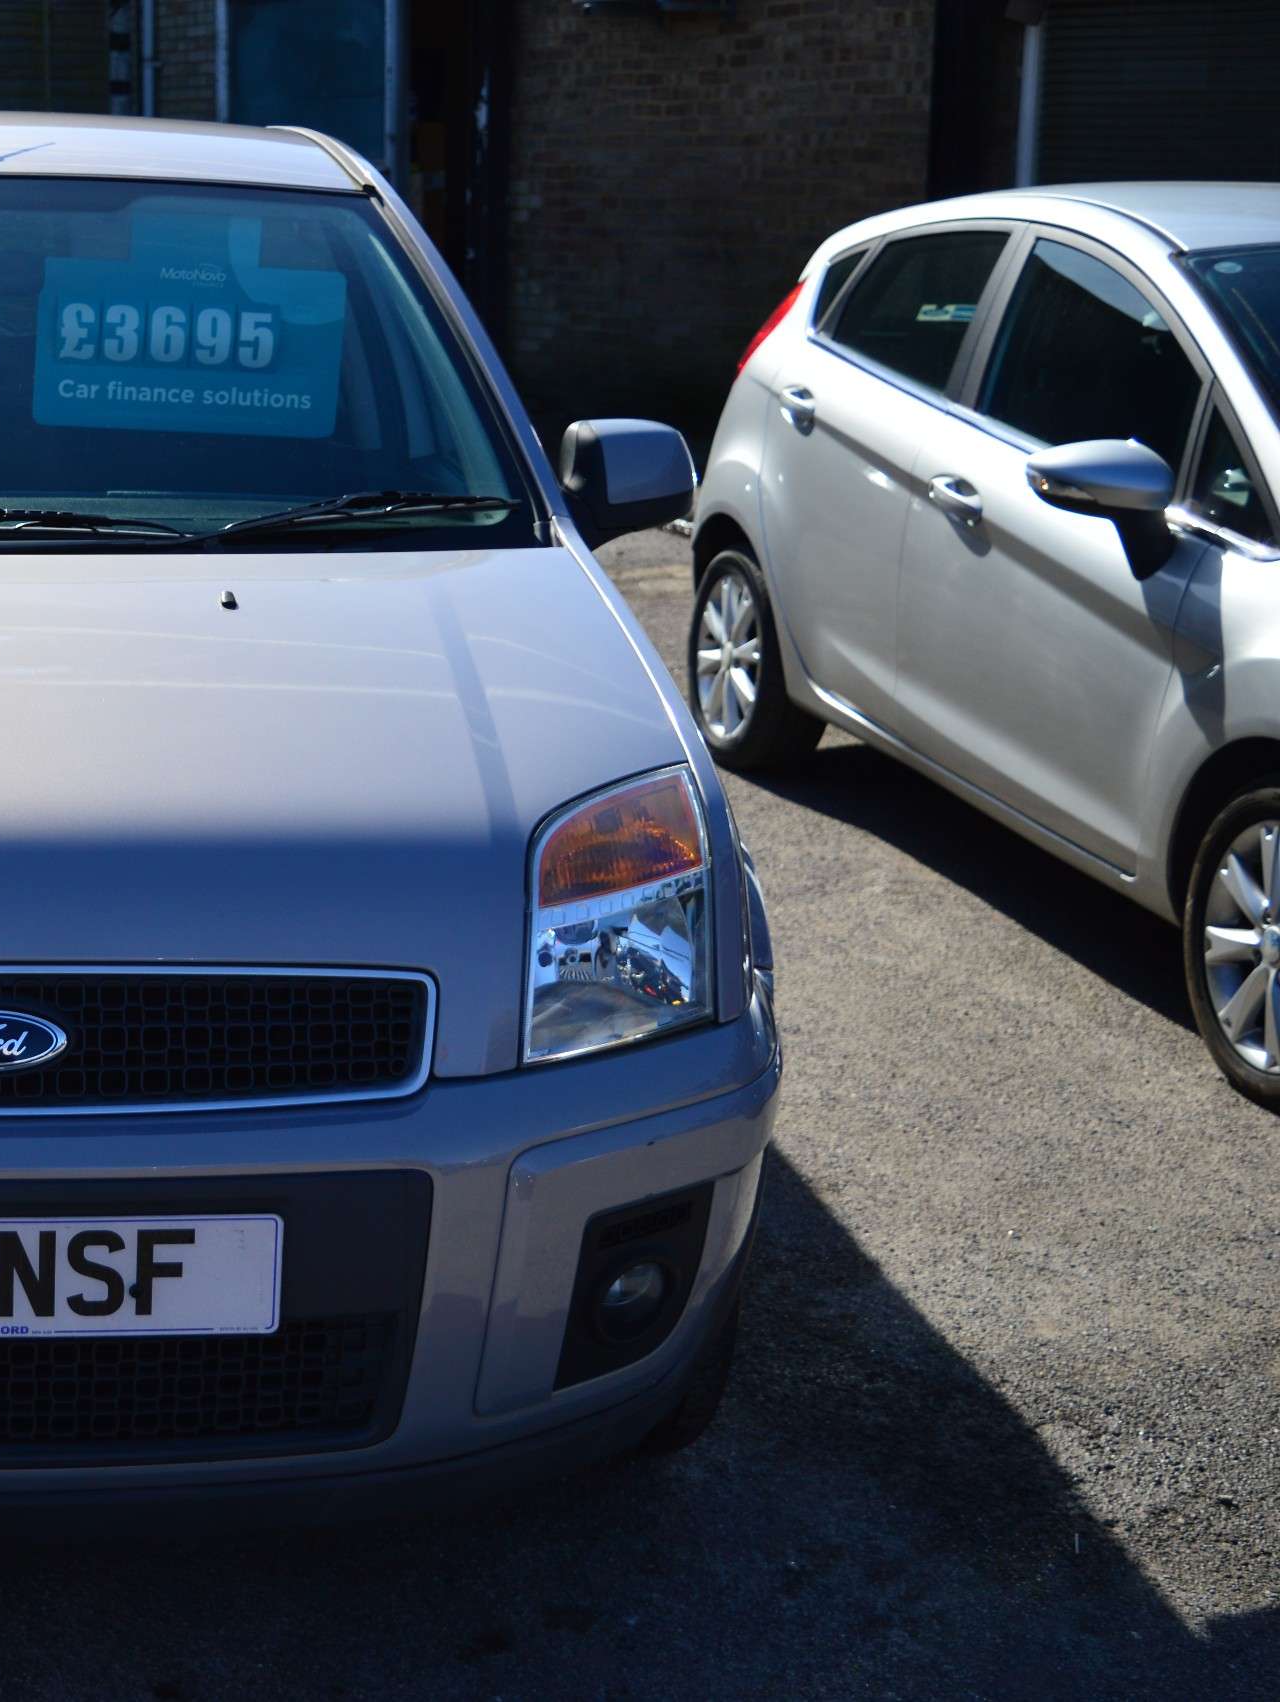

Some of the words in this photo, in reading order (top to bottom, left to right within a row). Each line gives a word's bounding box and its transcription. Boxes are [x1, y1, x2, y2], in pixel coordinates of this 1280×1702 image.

[160, 267, 226, 281] MotoNovo
[59, 303, 275, 369] £3695
[58, 379, 100, 399] Car
[107, 381, 194, 404] finance
[202, 387, 312, 409] solutions
